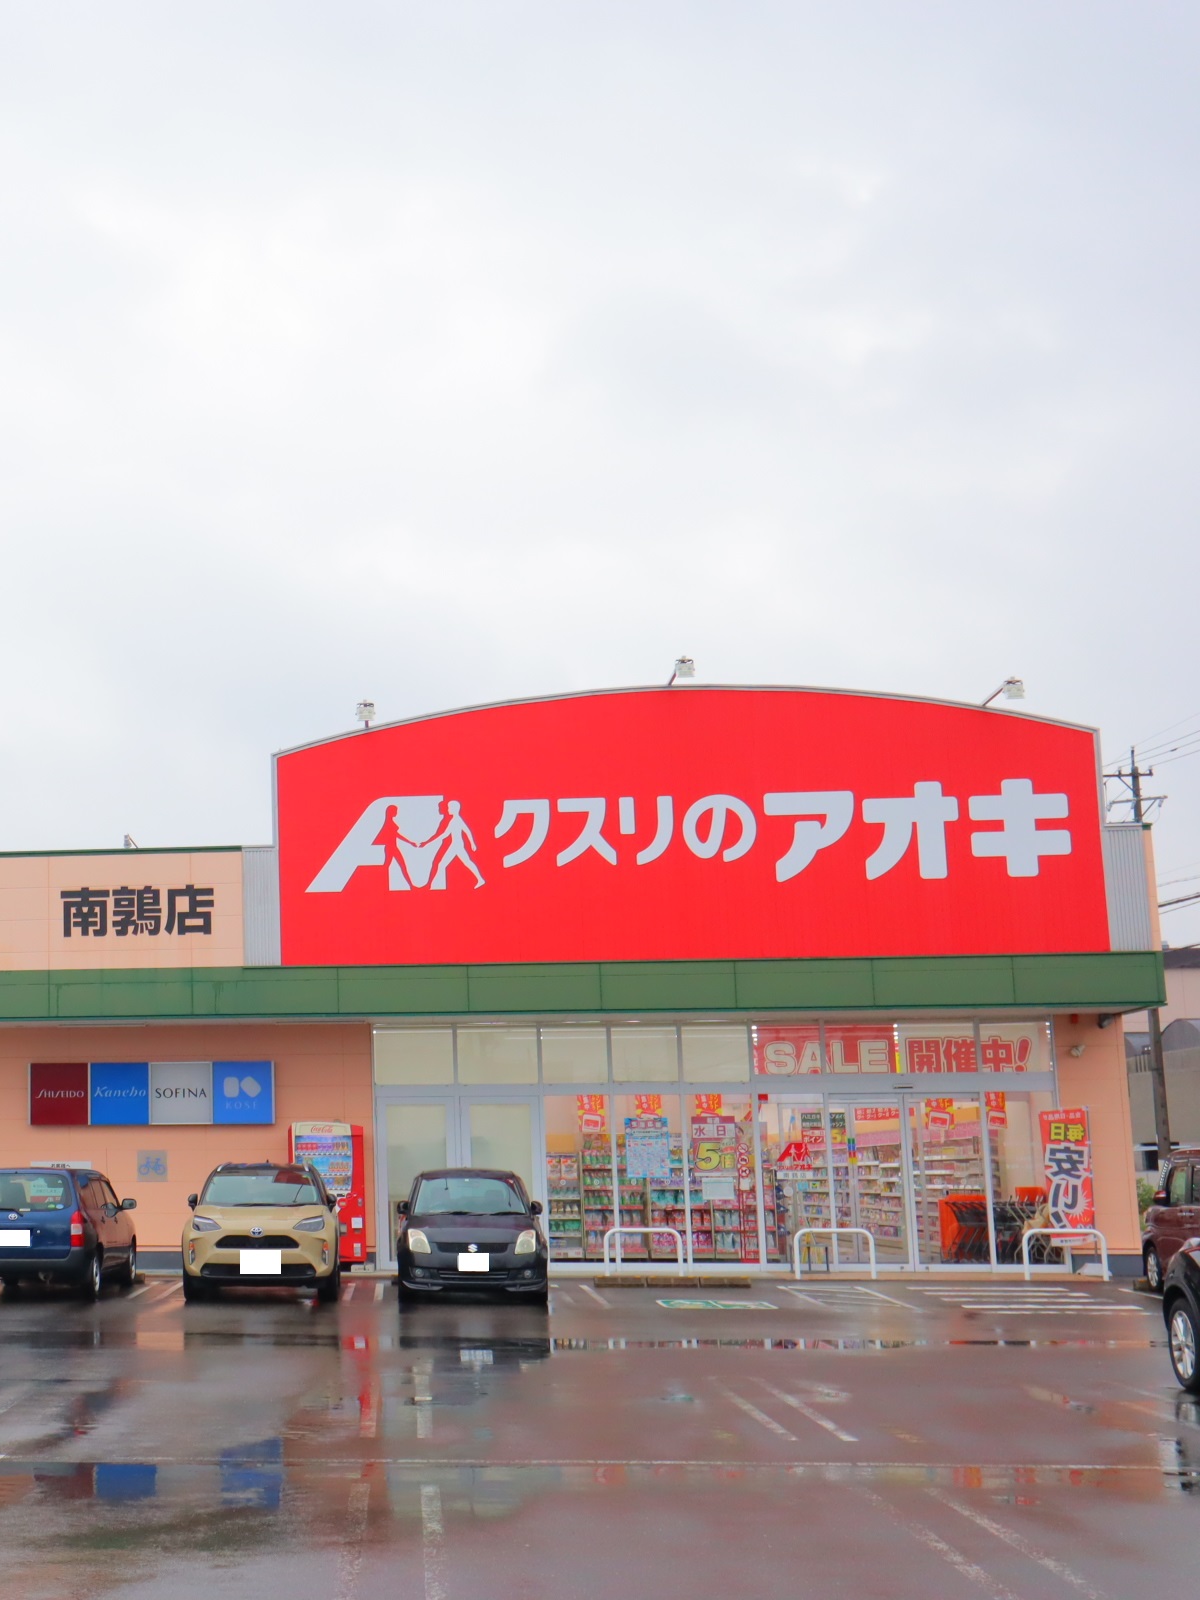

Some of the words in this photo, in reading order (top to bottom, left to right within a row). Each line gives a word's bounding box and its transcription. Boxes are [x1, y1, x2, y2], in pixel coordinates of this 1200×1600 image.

[495, 778, 1072, 881] クスリのアオキ
[60, 885, 214, 937] 南鶉店
[764, 1040, 891, 1074] SALE
[36, 1089, 85, 1098] SHISEIDO
[93, 1086, 147, 1098] Kanebo
[155, 1088, 208, 1099] SOFINA
